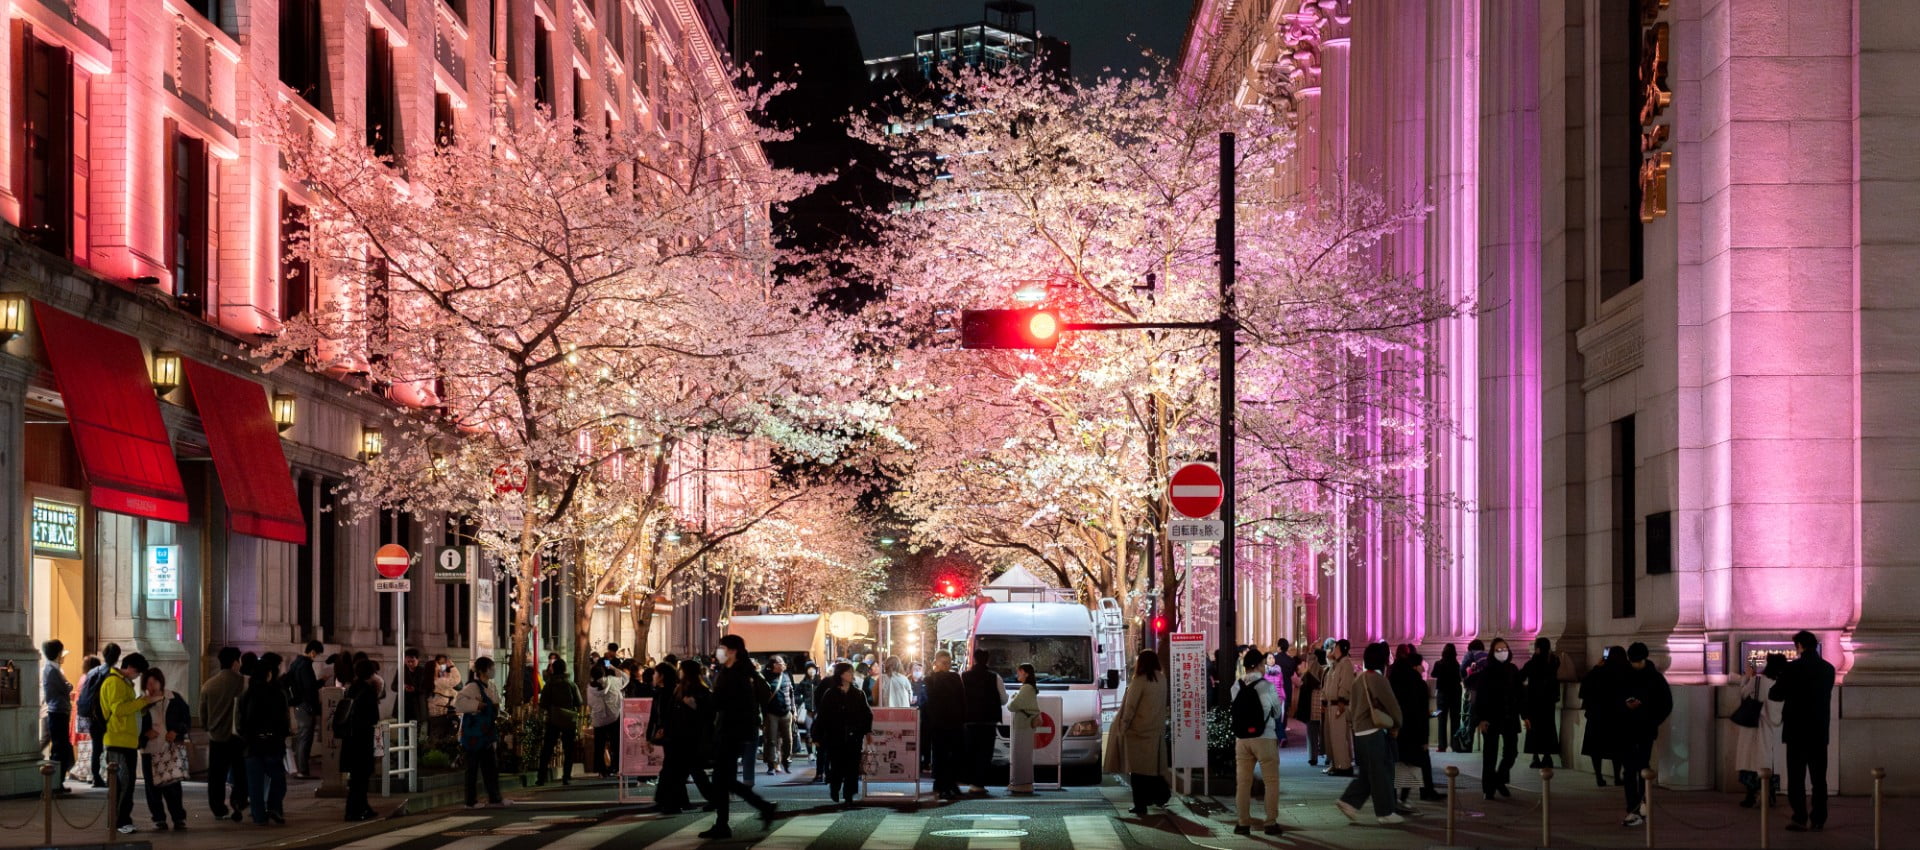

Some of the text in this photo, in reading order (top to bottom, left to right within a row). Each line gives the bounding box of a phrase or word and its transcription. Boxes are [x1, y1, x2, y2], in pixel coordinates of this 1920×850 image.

[1172, 524, 1220, 537] 自転車を除く
